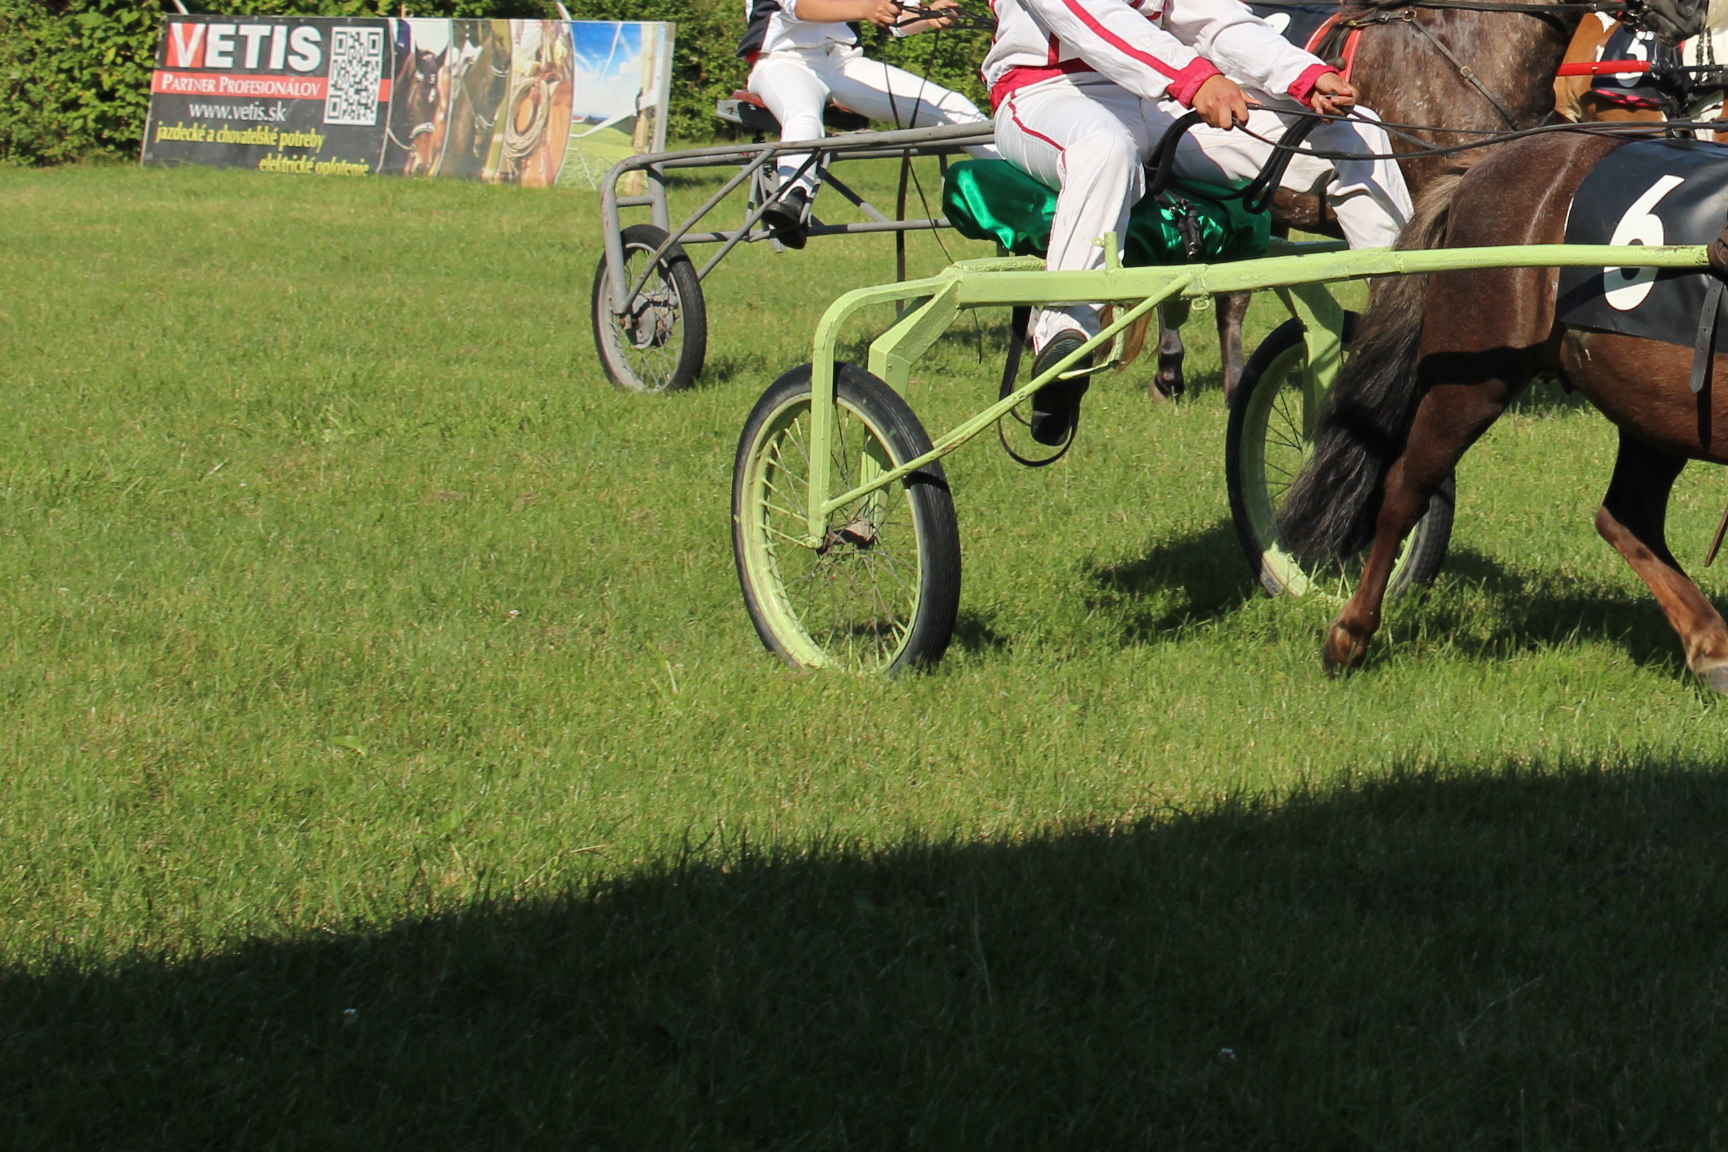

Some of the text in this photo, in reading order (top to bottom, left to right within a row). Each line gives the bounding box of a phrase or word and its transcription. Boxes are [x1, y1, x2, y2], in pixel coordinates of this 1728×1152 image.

[171, 23, 322, 73] VETIS
[189, 101, 286, 122] www.vetis.sk
[155, 121, 207, 143] jazdecké
[206, 128, 215, 143] a
[278, 128, 325, 153] potreby
[259, 153, 370, 177] elektrické oplotenie
[1604, 174, 1686, 311] 6
